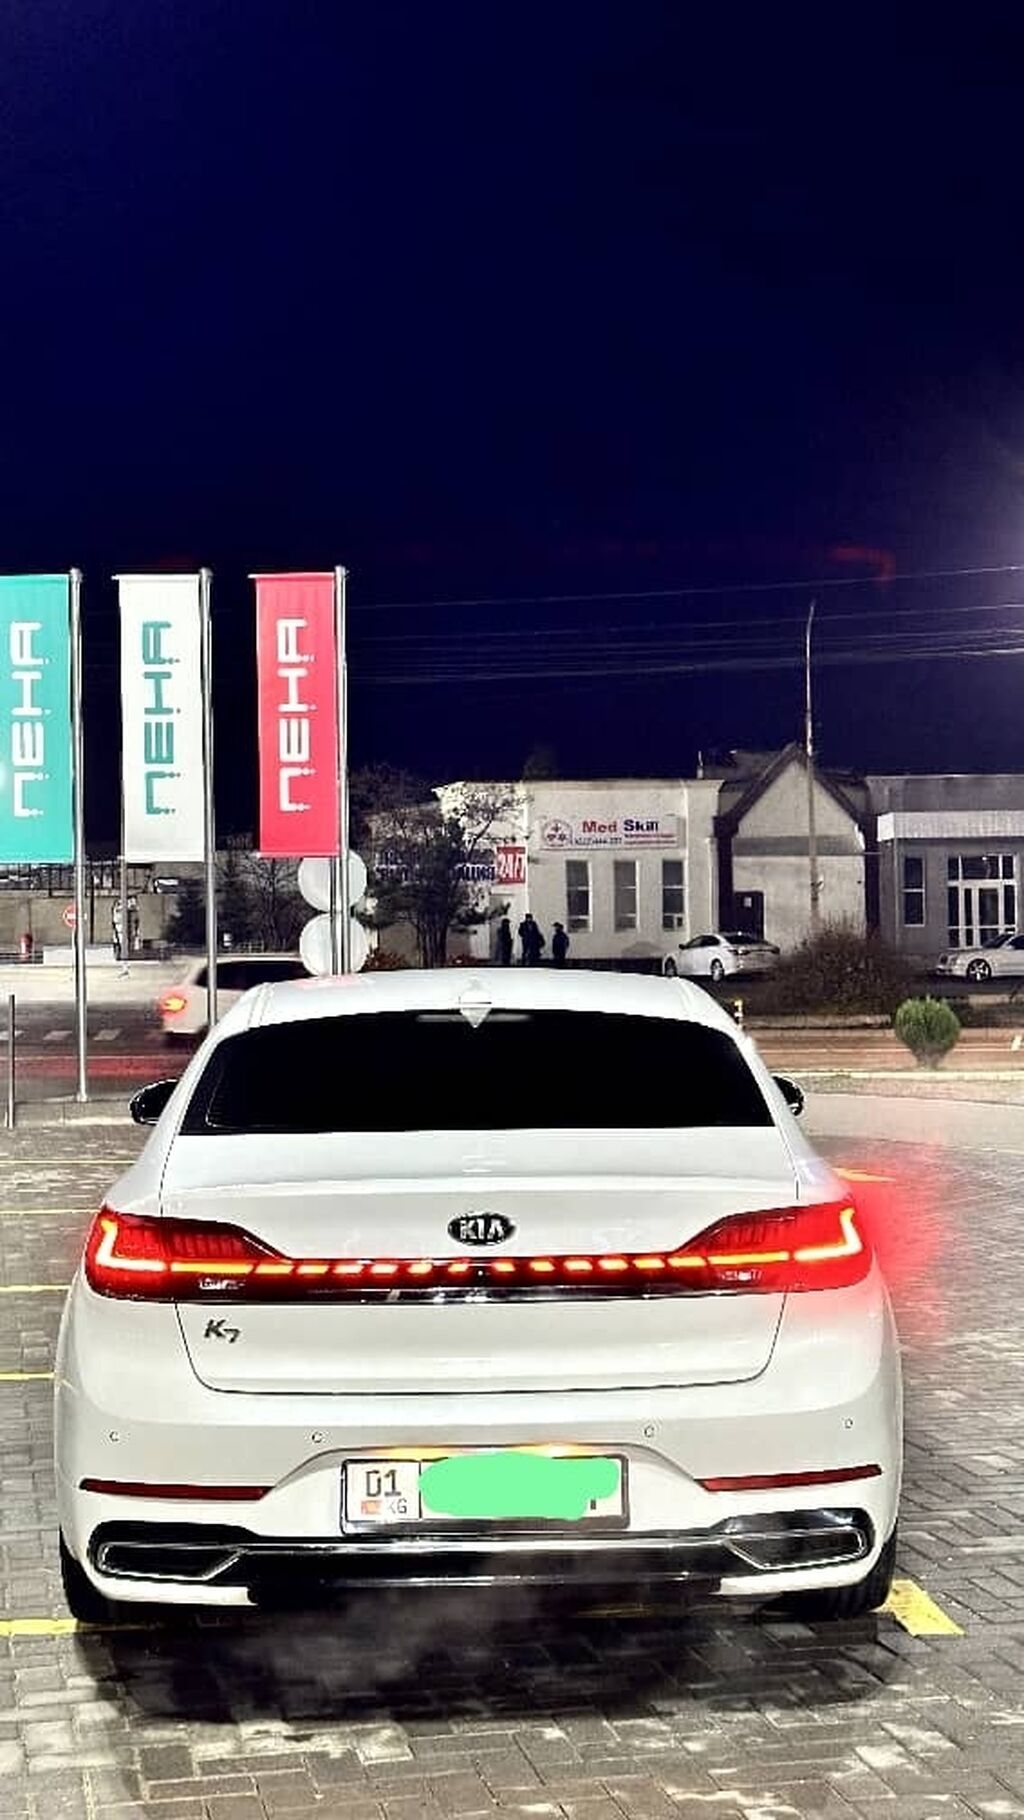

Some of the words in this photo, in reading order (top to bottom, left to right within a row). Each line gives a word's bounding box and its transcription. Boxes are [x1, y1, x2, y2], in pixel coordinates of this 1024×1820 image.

[582, 820, 618, 834] Med
[623, 818, 659, 832] Skill
[497, 852, 525, 879] 24/7
[459, 1218, 505, 1240] KIA
[204, 1319, 241, 1344] K7
[365, 1469, 402, 1497] 01
